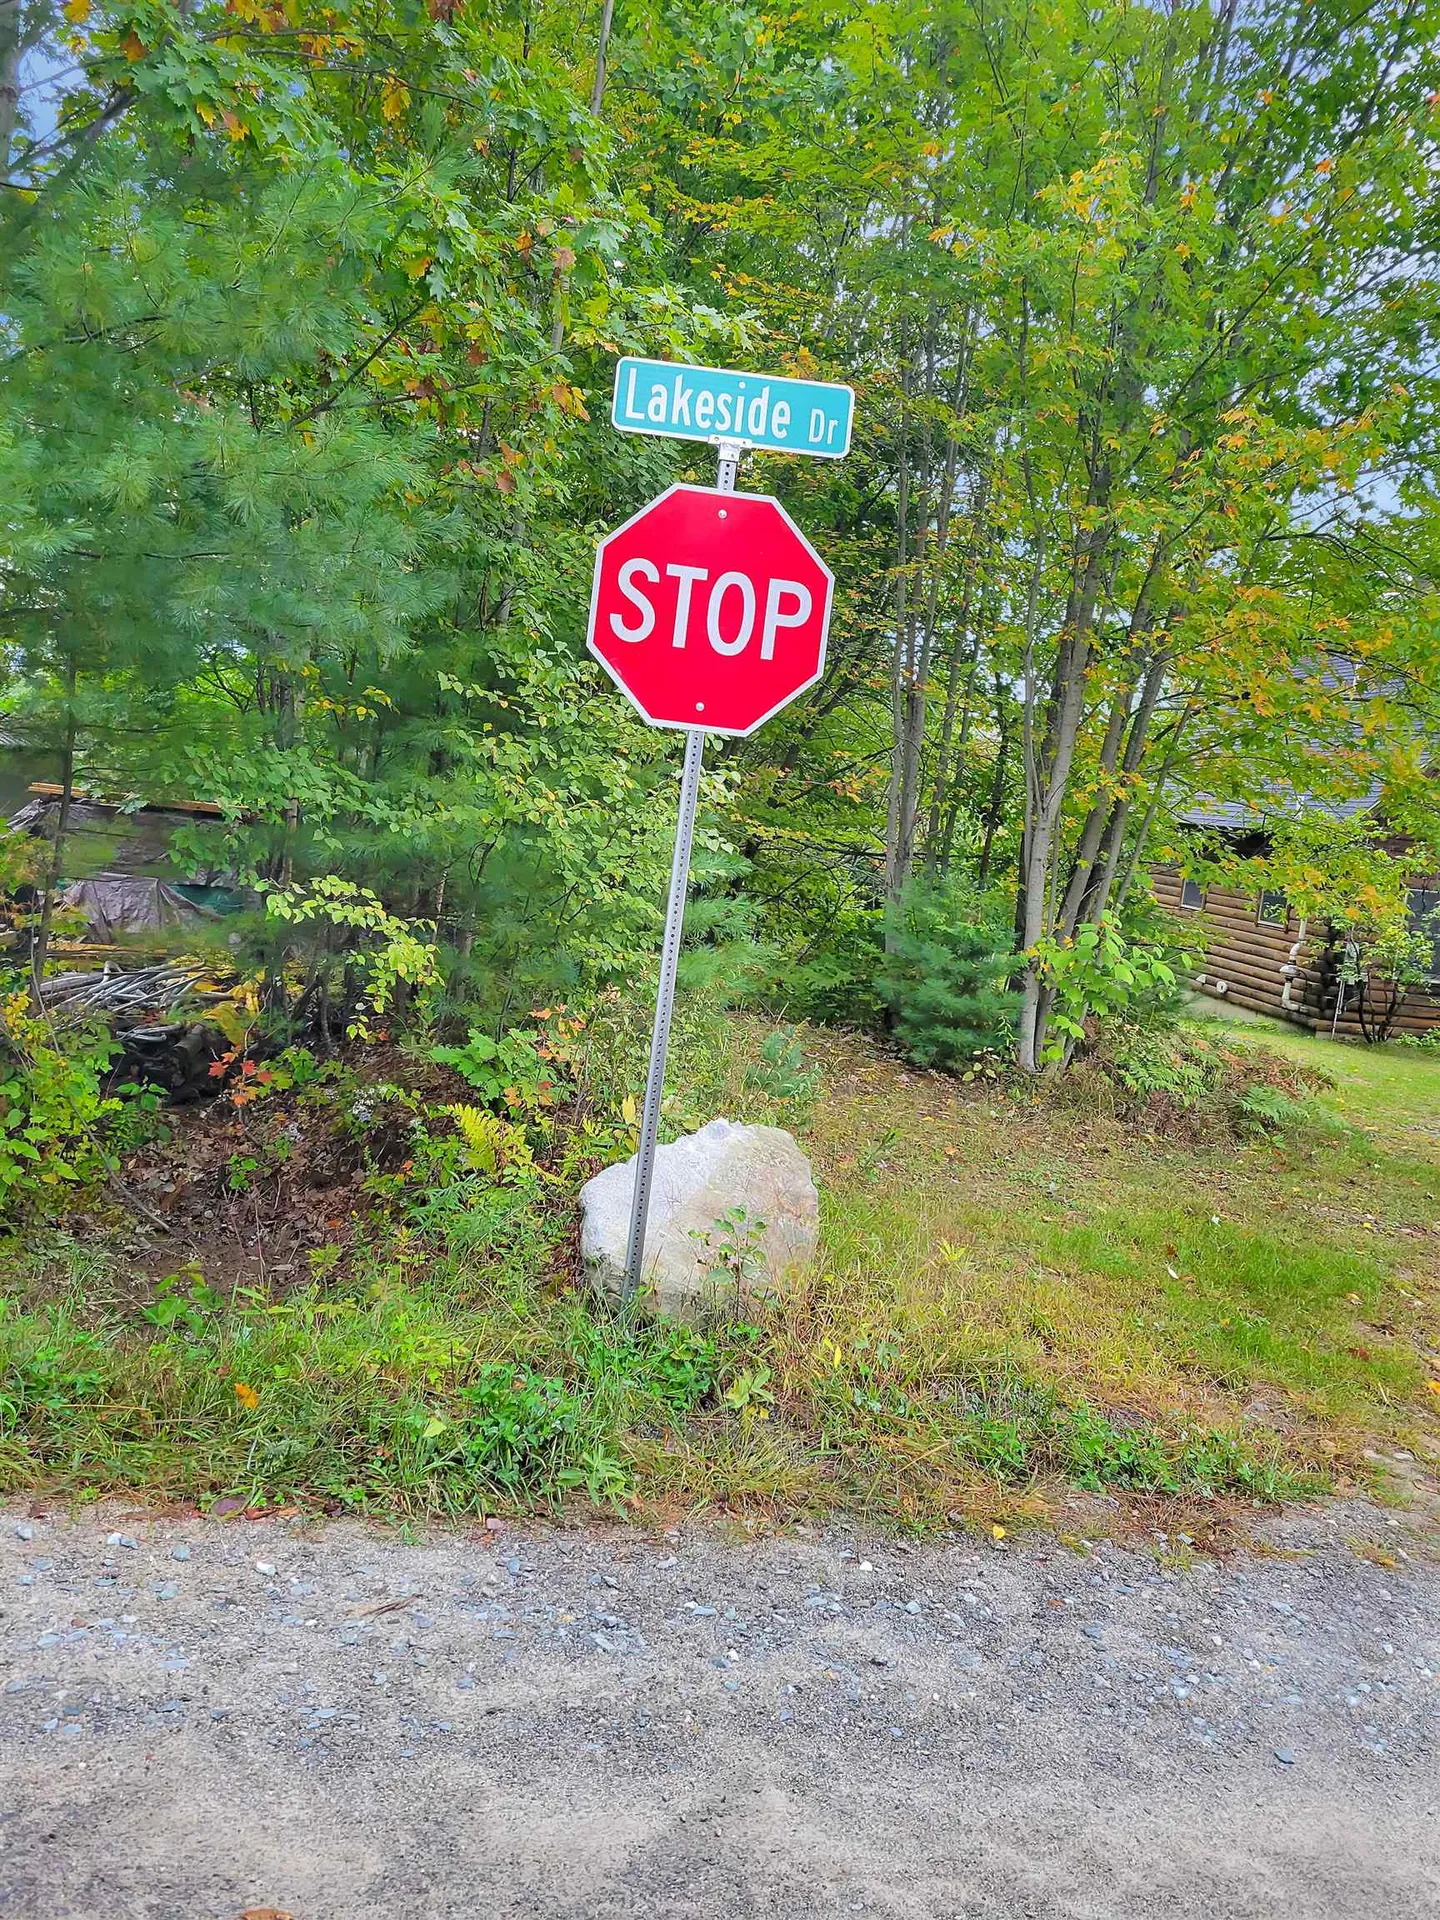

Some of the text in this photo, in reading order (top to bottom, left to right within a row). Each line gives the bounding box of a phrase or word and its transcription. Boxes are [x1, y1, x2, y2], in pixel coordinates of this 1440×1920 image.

[625, 367, 839, 445] Lakeside Dr
[609, 557, 812, 661] STOP
